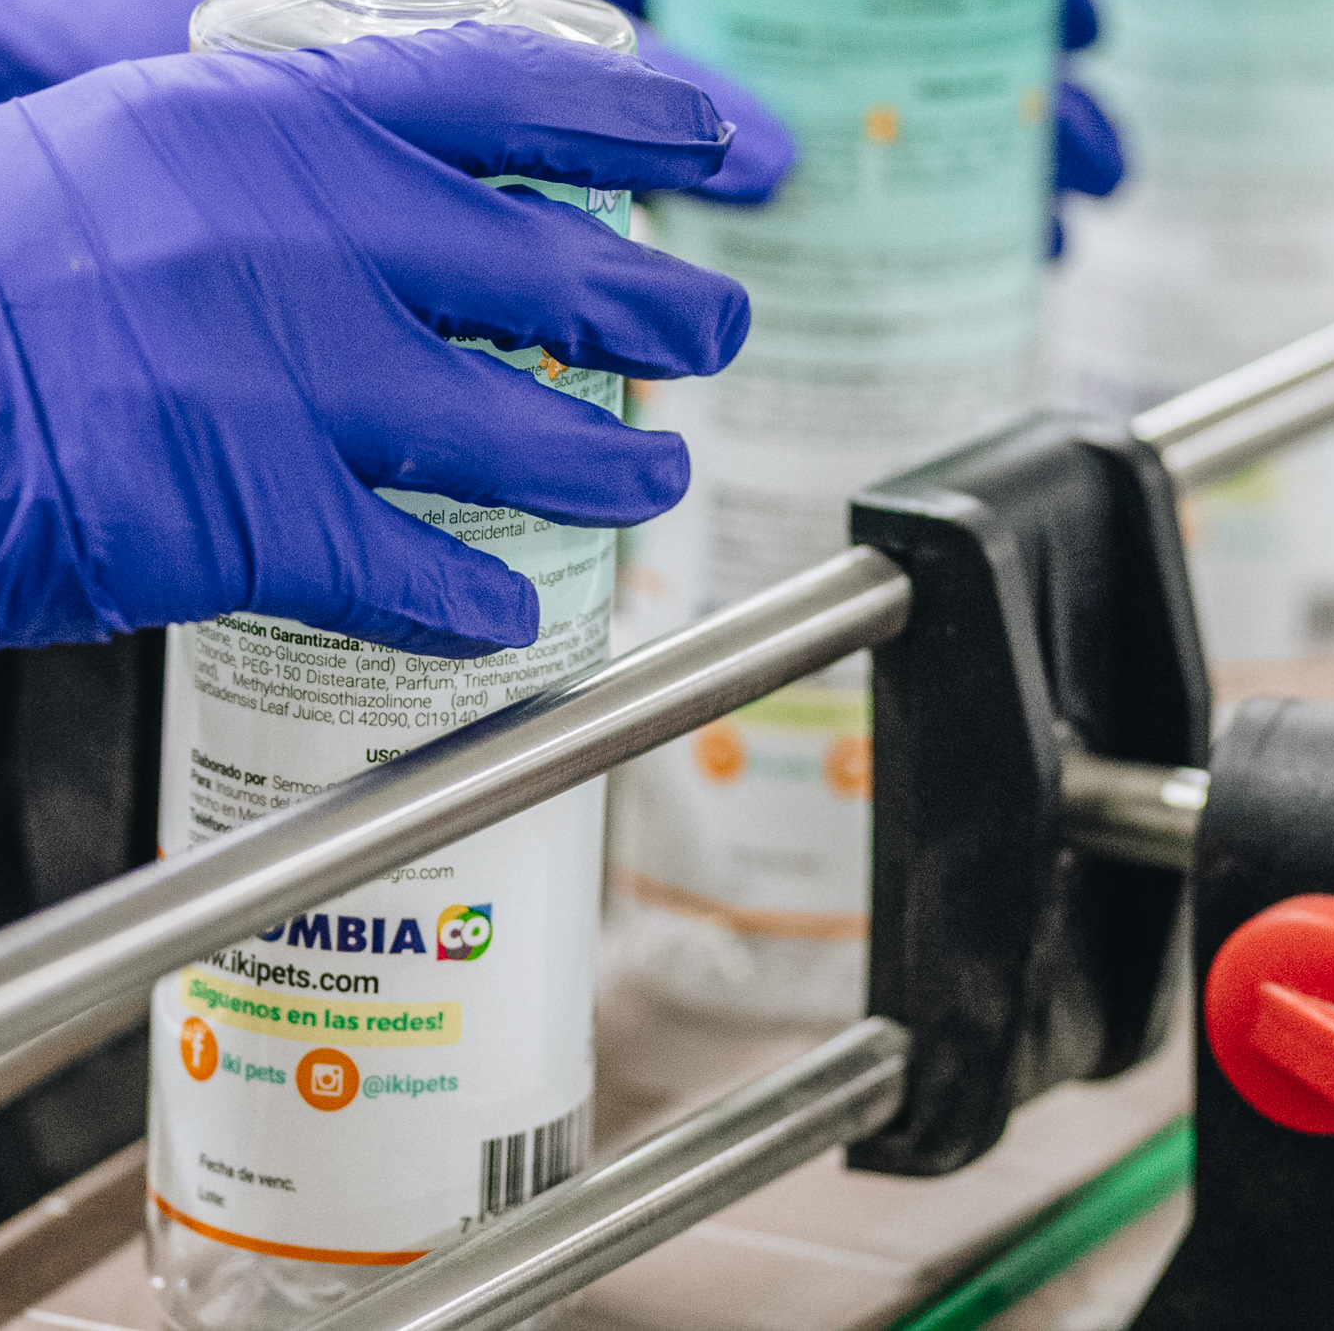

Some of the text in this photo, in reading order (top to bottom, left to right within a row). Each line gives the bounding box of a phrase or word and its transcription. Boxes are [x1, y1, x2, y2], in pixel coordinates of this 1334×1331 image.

[423, 509, 445, 524] del
[449, 508, 505, 524] alcance
[455, 520, 525, 542] accidental
[271, 626, 365, 652] Garantizada:
[238, 636, 347, 669] Coco-Glucoside
[355, 655, 396, 675] (and)
[405, 656, 465, 675] Glyceryl
[242, 656, 301, 682] PEG-150
[306, 669, 389, 692] Distearate,
[395, 676, 457, 692] Parfum,
[231, 671, 433, 709] Methylchloroisothiazolinone
[450, 690, 488, 710] (and)
[260, 698, 291, 717] Leaf
[292, 703, 336, 725] Juice,
[358, 711, 411, 729] 42090,
[216, 779, 267, 807] Insumos
[287, 1008, 316, 1027] en
[324, 1008, 359, 1031] las
[367, 1011, 444, 1032] redes!
[221, 1052, 242, 1075] iki
[245, 1061, 287, 1085] pets
[362, 1074, 459, 1099] @ikipets
[237, 1167, 255, 1184] de
